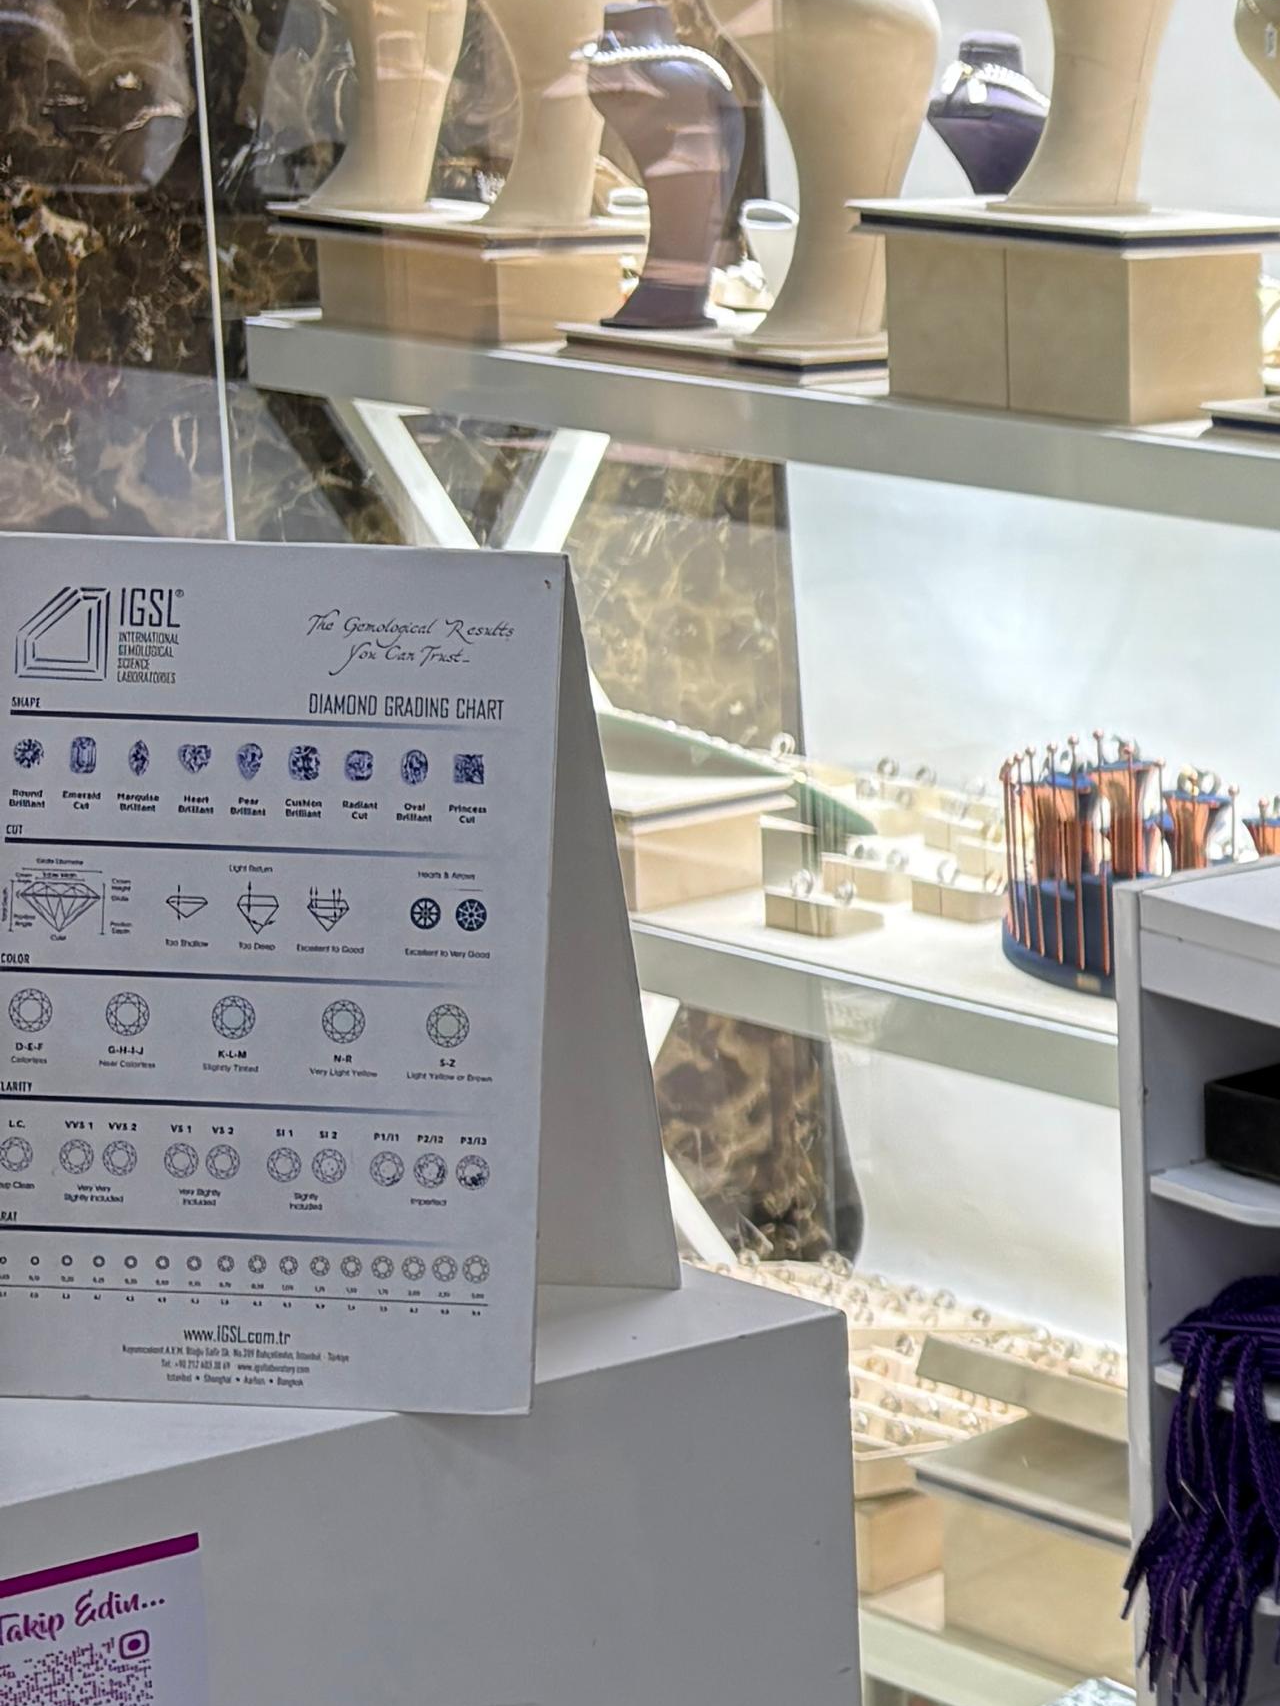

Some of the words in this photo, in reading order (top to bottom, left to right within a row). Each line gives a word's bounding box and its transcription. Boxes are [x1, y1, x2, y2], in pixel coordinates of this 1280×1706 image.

[306, 609, 340, 636] The
[343, 616, 438, 648] Gemological
[445, 619, 515, 645] Results
[118, 632, 179, 645] INTERNATIONAL
[117, 658, 150, 670] SCIENCE
[328, 642, 377, 676] You
[385, 645, 414, 662] Can
[11, 697, 41, 708] SHAPE
[309, 693, 377, 716] DIAMOND
[384, 696, 449, 718] GRADING
[456, 698, 504, 720] CHART
[183, 795, 209, 804] Heart
[342, 800, 378, 810] Radiant
[404, 802, 425, 811] Oval
[6, 824, 23, 835] CUT
[1, 953, 31, 964] COLOR
[0, 1081, 33, 1092] LARITY
[183, 1324, 291, 1345] www.IGSL.com.tr
